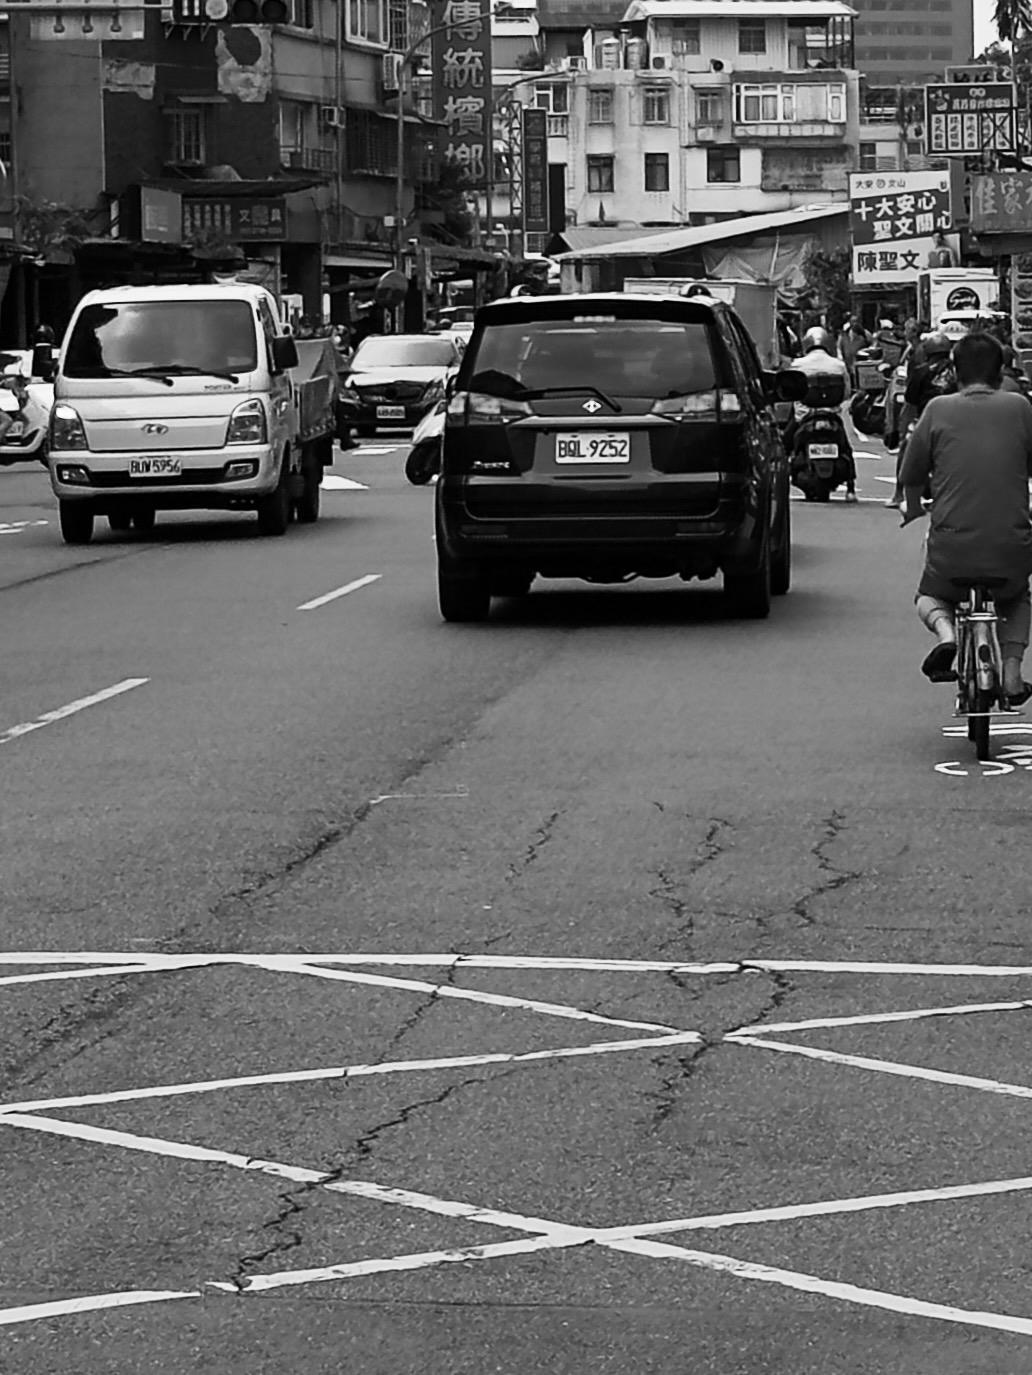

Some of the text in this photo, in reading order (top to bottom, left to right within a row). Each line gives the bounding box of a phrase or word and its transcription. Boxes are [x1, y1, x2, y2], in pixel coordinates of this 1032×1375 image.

[442, 0, 486, 183] 傳統檳榔
[854, 191, 937, 221] 十大安心
[872, 210, 952, 241] 聖文關心
[857, 248, 920, 273] 陳聖文
